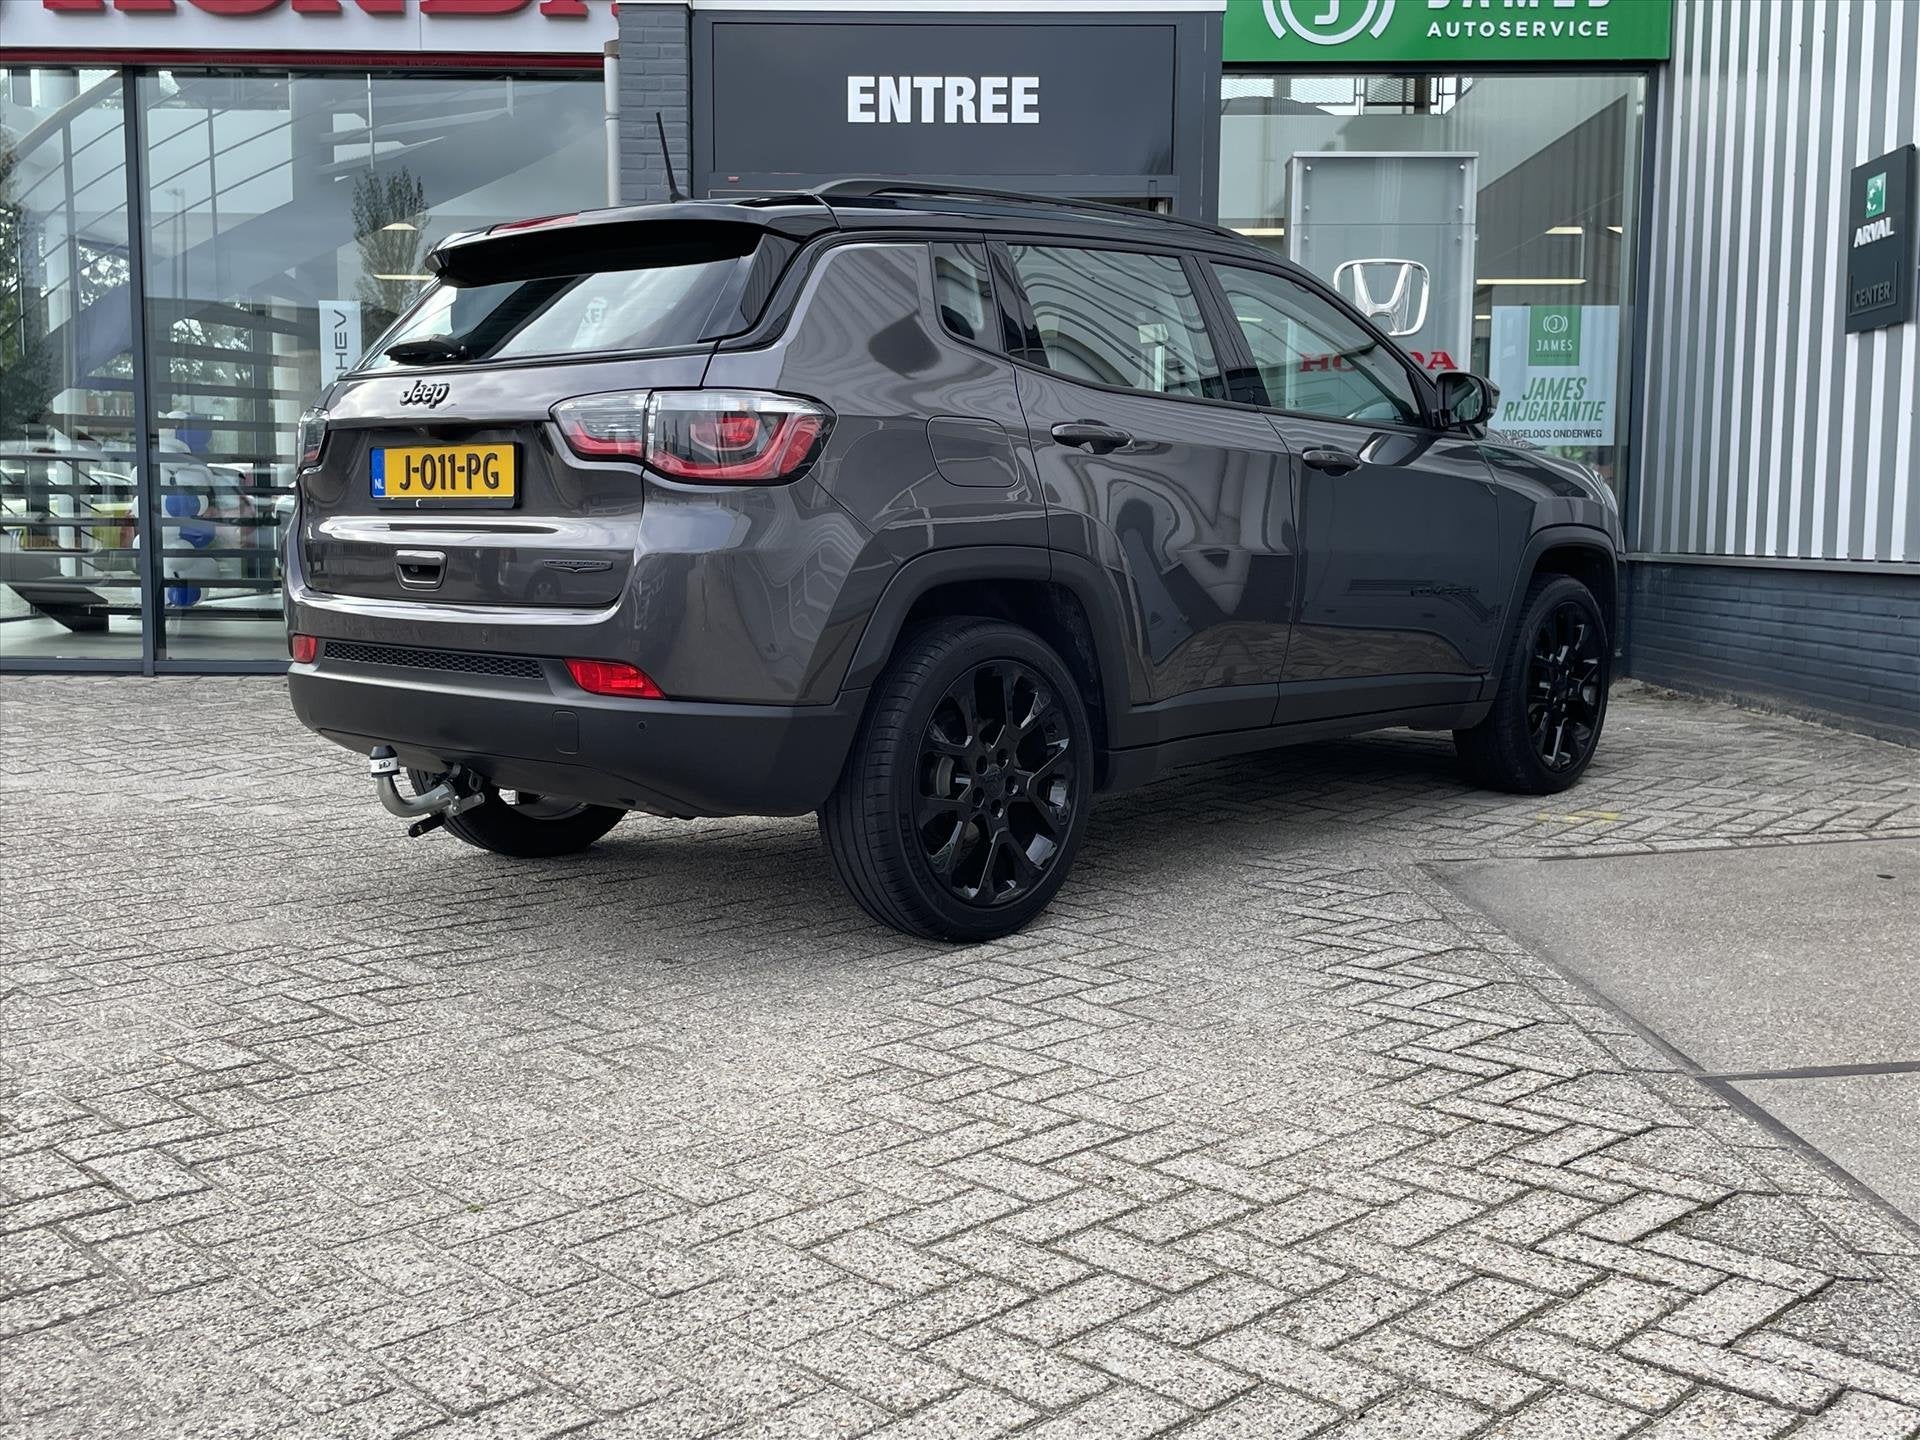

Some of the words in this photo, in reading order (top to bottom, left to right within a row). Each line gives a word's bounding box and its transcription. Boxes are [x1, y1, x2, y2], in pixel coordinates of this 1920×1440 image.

[1427, 21, 1609, 38] AUTOSERVICE
[847, 76, 1040, 124] ENTREE
[1853, 217, 1895, 248] ARVAL
[1854, 281, 1892, 307] CENTER
[333, 309, 348, 370] HEV
[1536, 339, 1573, 352] JAMES
[1298, 351, 1458, 372] HOA
[400, 379, 450, 409] Jeep
[1522, 377, 1588, 401] JAMES
[1502, 401, 1606, 422] RIJGARANTIE
[1553, 429, 1602, 439] ONDERWEG
[399, 452, 500, 491] J-011-PG
[374, 478, 385, 490] NL
